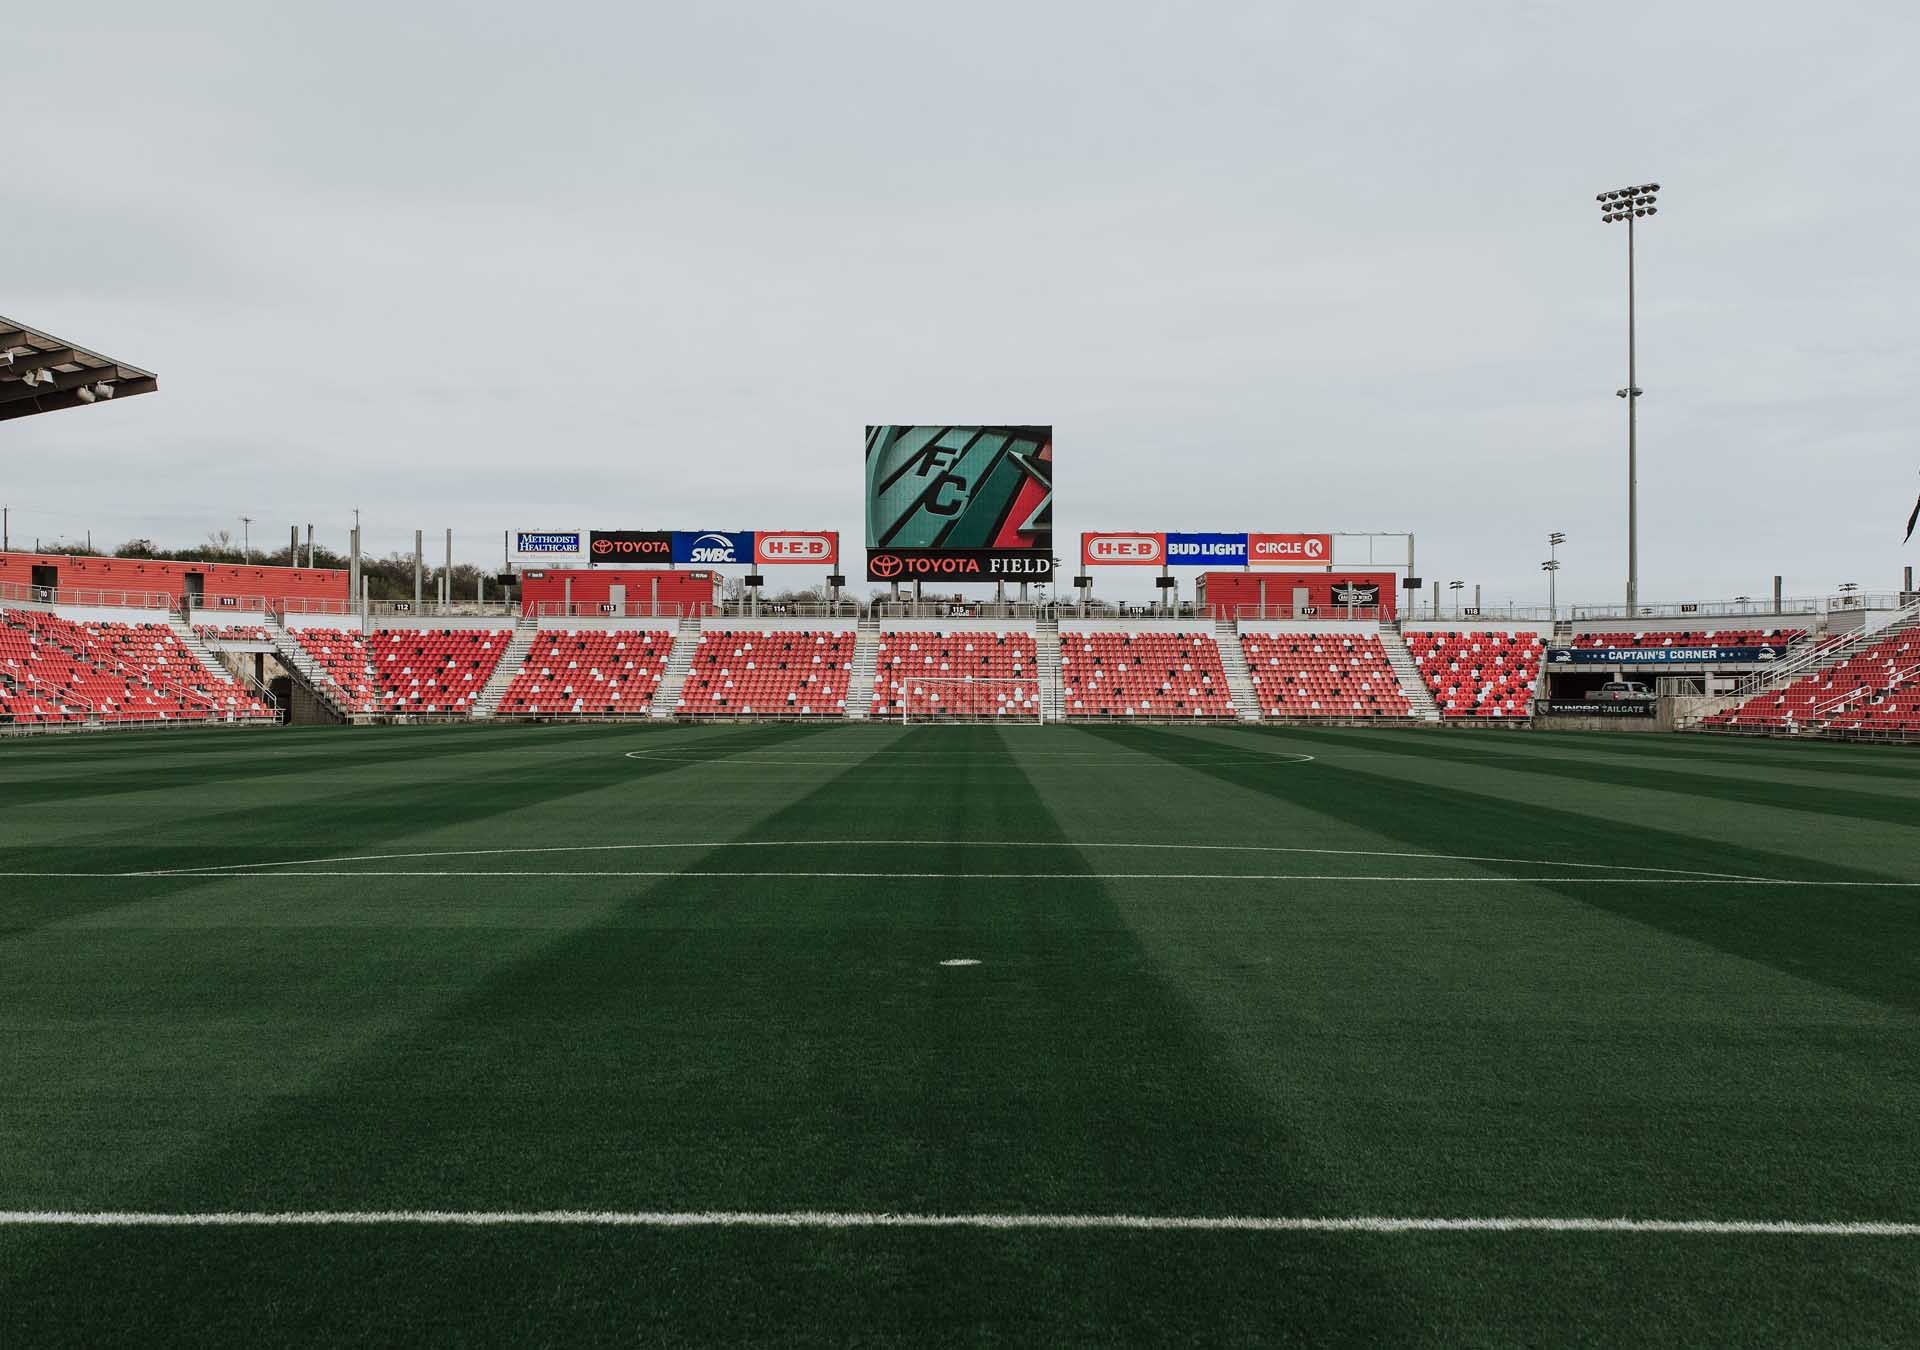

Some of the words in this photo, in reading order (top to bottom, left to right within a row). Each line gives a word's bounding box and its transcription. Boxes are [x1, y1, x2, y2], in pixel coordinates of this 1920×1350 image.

[521, 534, 577, 543] METHODIST
[520, 543, 578, 551] HEALTHCARE
[614, 541, 670, 553] TOYOTA
[1168, 543, 1200, 555] BUD
[1201, 543, 1246, 555] LIGHT
[1255, 542, 1302, 554] CIRCLE
[690, 548, 735, 562] SWBC
[905, 558, 980, 573] TOYOTA
[990, 558, 1051, 573] FIELD
[1608, 650, 1666, 660] CAPTAIN'S
[1670, 650, 1717, 659] CORNER
[1601, 705, 1644, 713] TAILGATE
